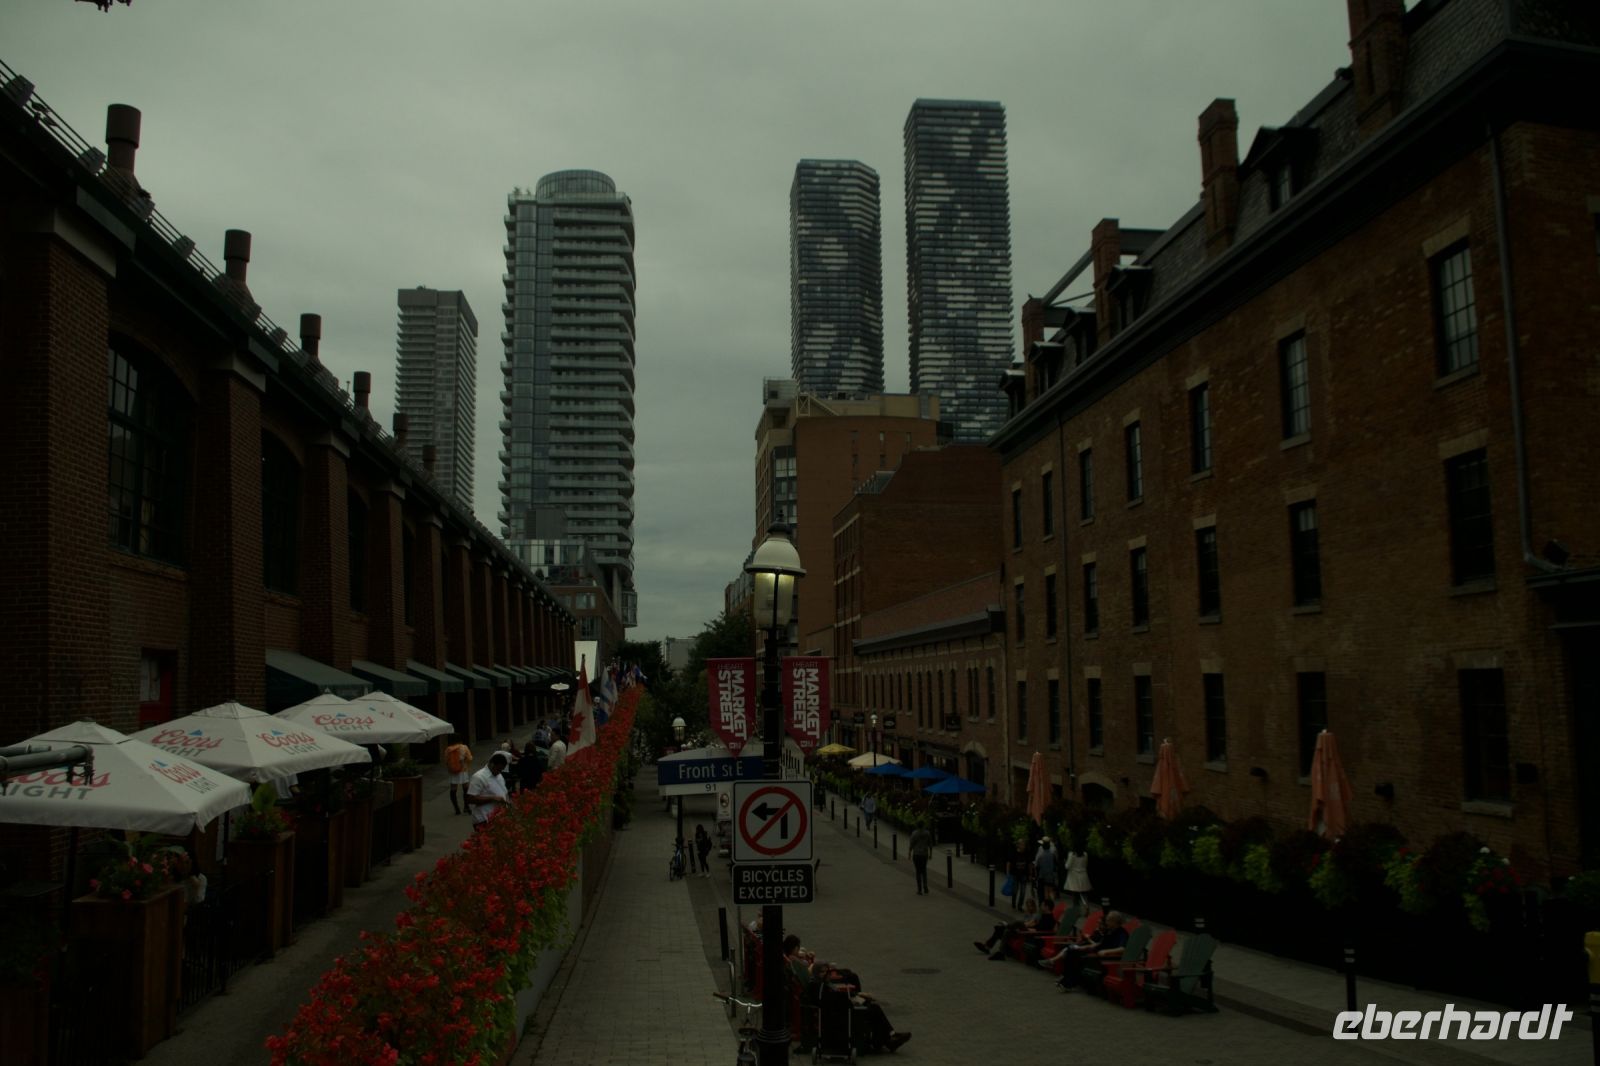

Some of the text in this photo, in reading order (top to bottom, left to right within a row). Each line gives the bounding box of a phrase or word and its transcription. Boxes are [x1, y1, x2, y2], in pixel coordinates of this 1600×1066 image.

[718, 669, 735, 733] STREET
[731, 669, 747, 740] MARKET
[793, 668, 807, 732] STREET
[806, 667, 820, 739] MARKET
[311, 714, 375, 726] Coors
[152, 729, 225, 749] Coors
[256, 730, 315, 748] Coors
[152, 744, 206, 757] IGHT
[280, 742, 322, 755] LIGHT
[678, 760, 744, 780] Front St E
[0, 785, 93, 799] IGHT
[705, 783, 717, 792] 91
[741, 869, 804, 883] BICYCLES
[738, 885, 808, 900] EXCEPTED
